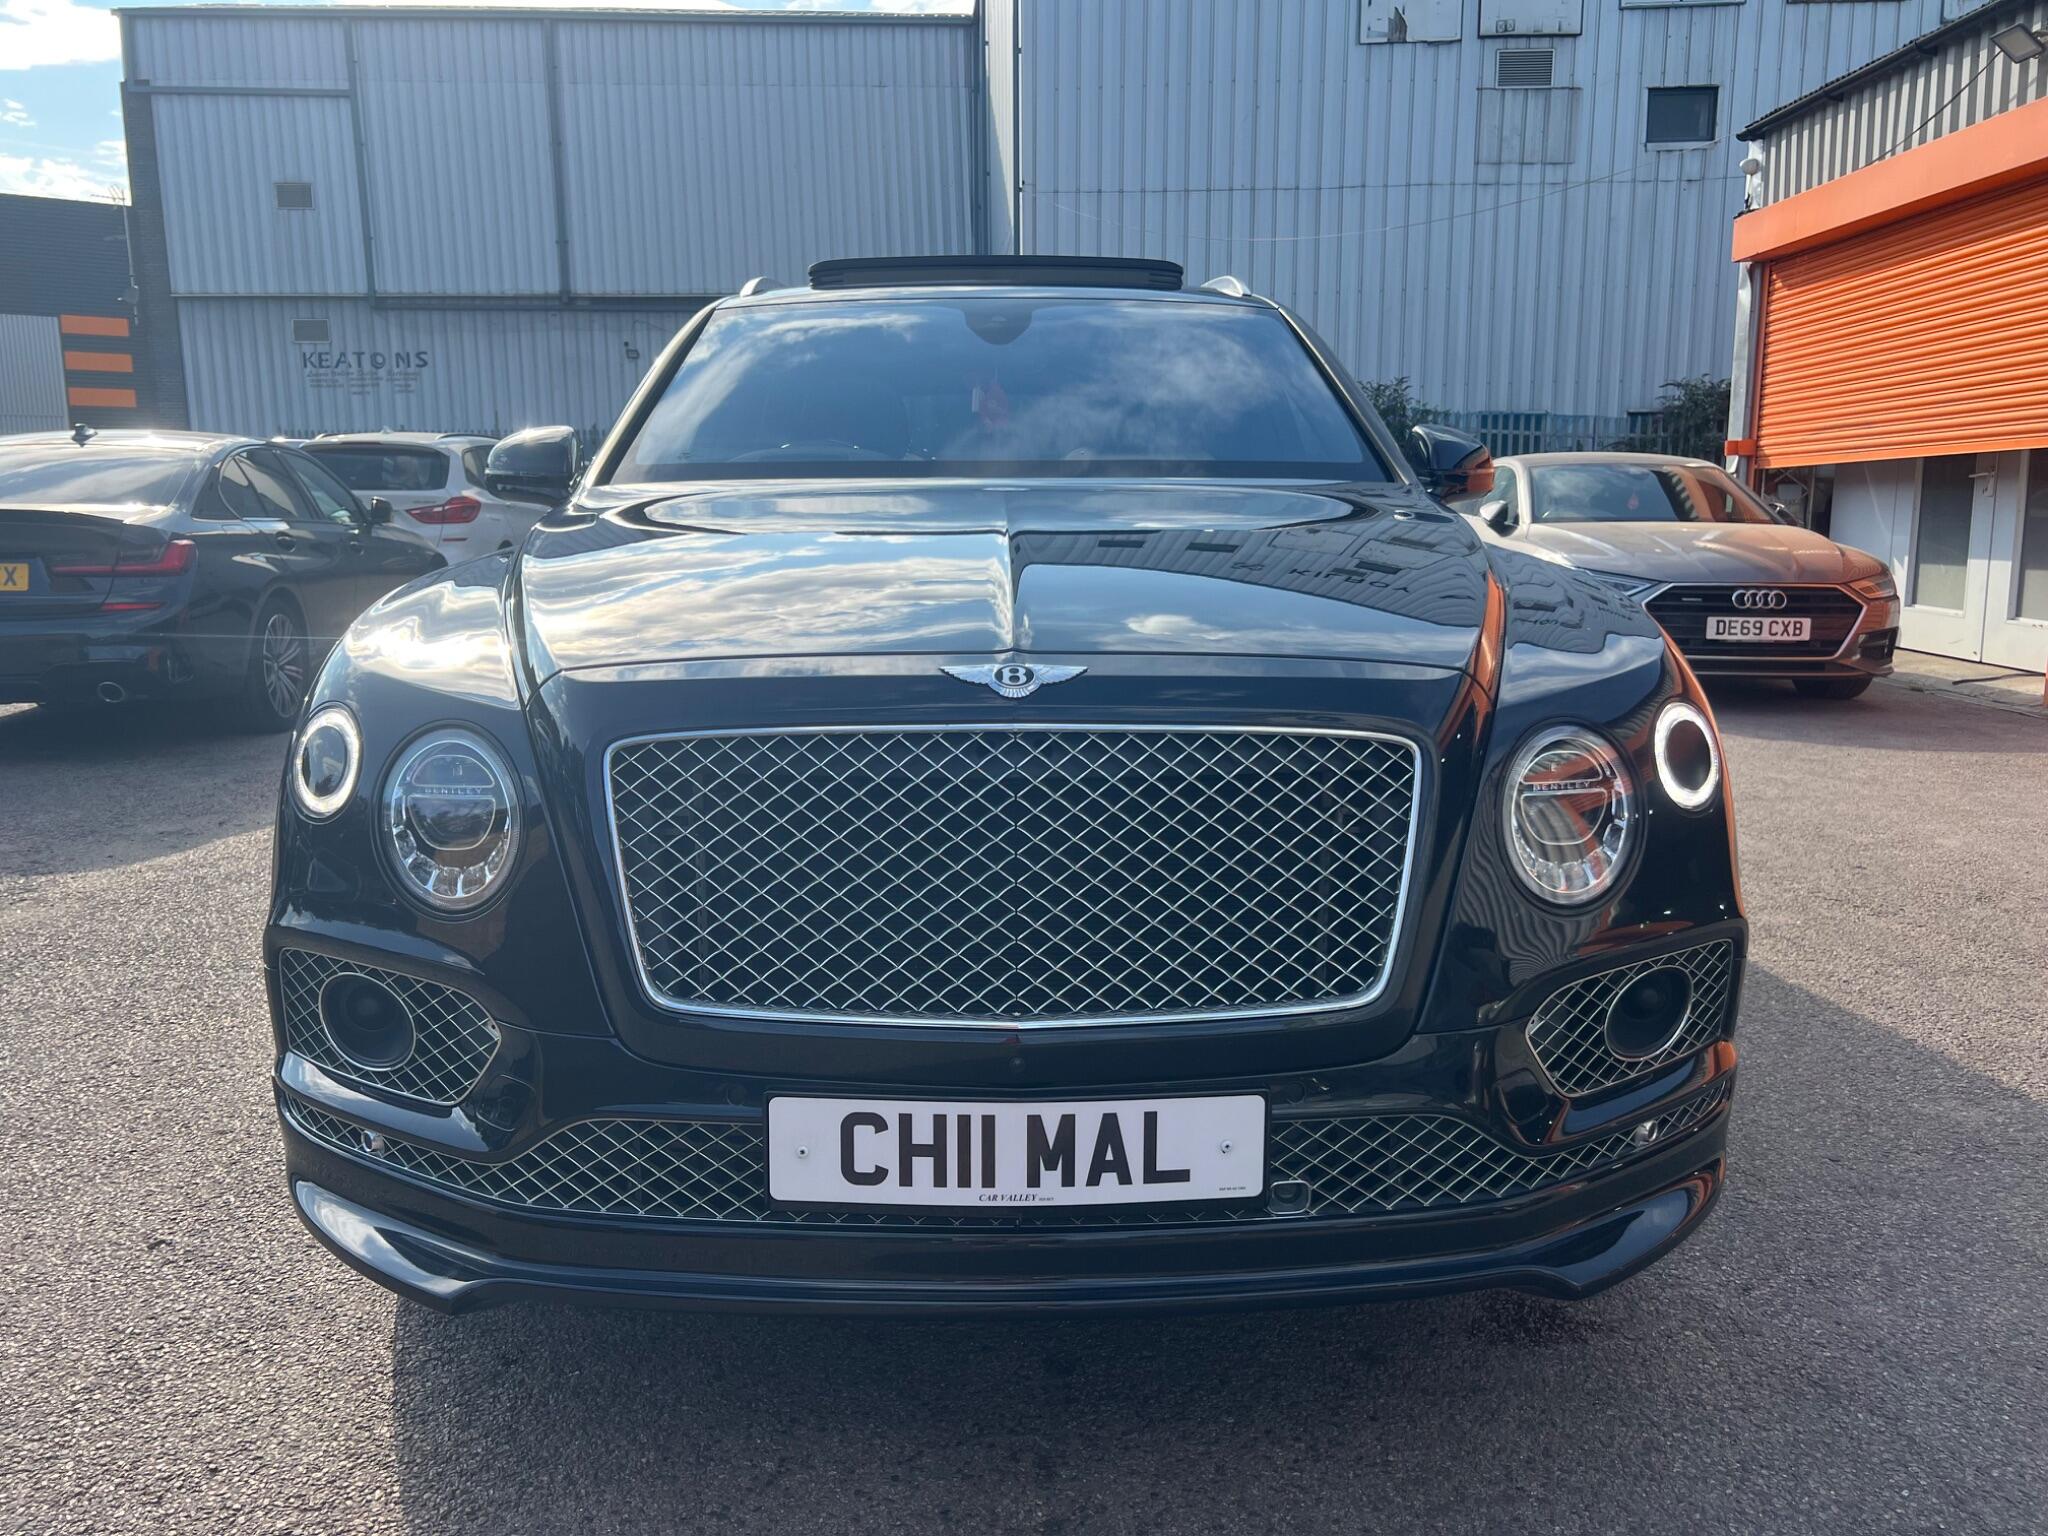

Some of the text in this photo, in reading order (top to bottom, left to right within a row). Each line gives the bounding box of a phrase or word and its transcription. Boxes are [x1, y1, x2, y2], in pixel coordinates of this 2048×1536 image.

[303, 351, 429, 369] KEATONS
[0, 566, 17, 586] X
[1715, 619, 1804, 636] DE69 CXB
[1002, 668, 1027, 684] B
[1533, 781, 1590, 791] BENTLEY
[1026, 1110, 1191, 1188] MAL
[979, 1193, 998, 1202] CAR
[1000, 1193, 1038, 1202] VALLEY
